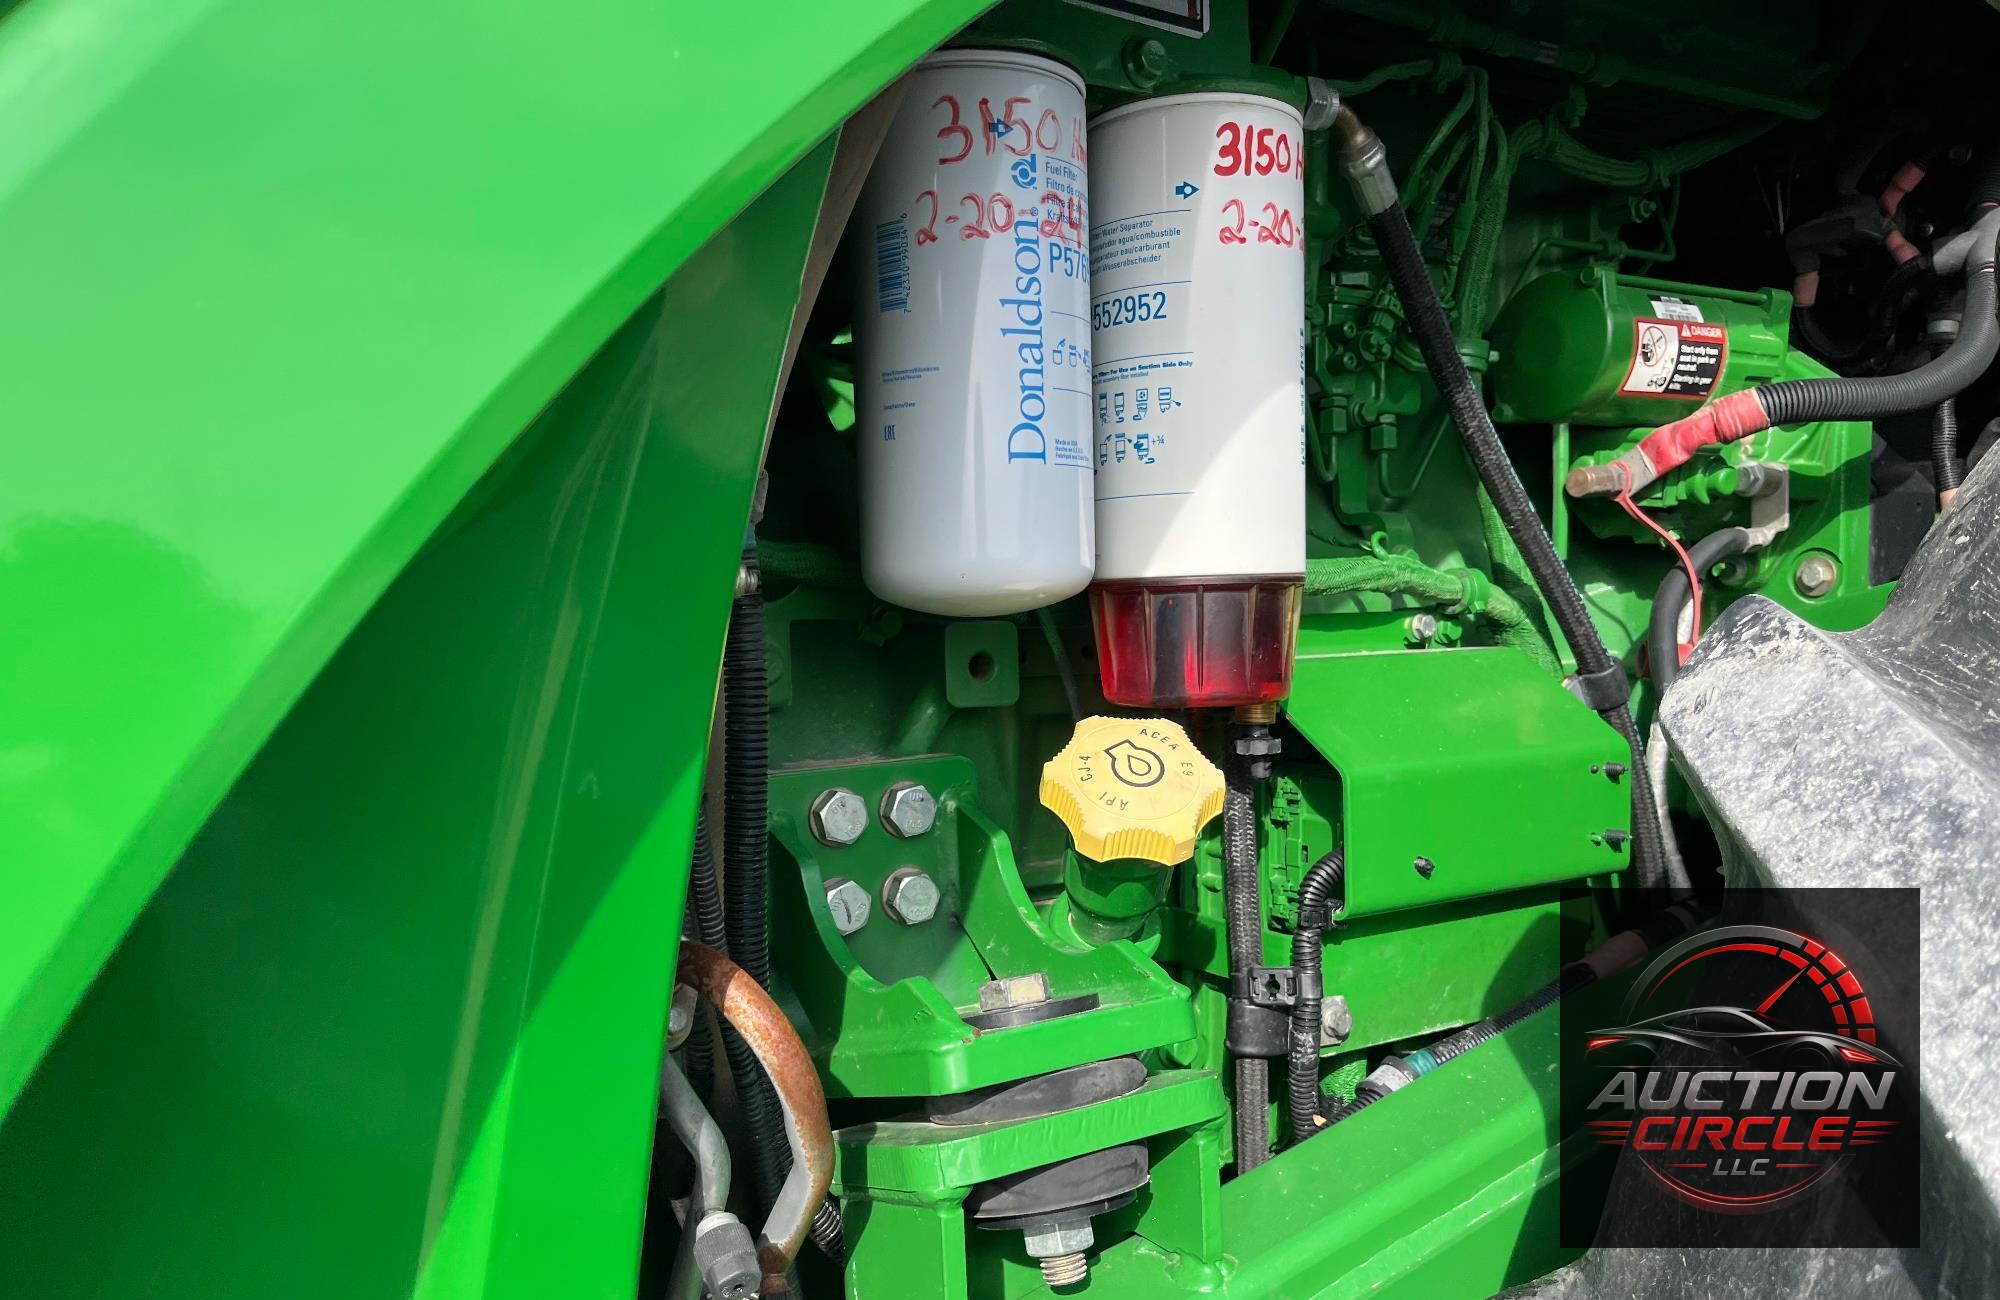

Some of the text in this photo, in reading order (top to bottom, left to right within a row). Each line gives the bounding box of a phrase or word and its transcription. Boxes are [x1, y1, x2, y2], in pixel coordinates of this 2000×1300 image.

[931, 95, 1062, 166] 3150
[1214, 121, 1292, 177] 3150
[1045, 162, 1061, 176] Fuel
[1046, 177, 1065, 193] Filtro
[1066, 184, 1074, 196] de
[1119, 219, 1153, 233] Separator
[1091, 291, 1167, 332] 552952
[1691, 325, 1722, 338] DANGER
[1694, 346, 1706, 356] only
[1178, 360, 1193, 368] Only
[1139, 727, 1194, 778] ACEA E9
[1077, 754, 1129, 811] API CJ-4
